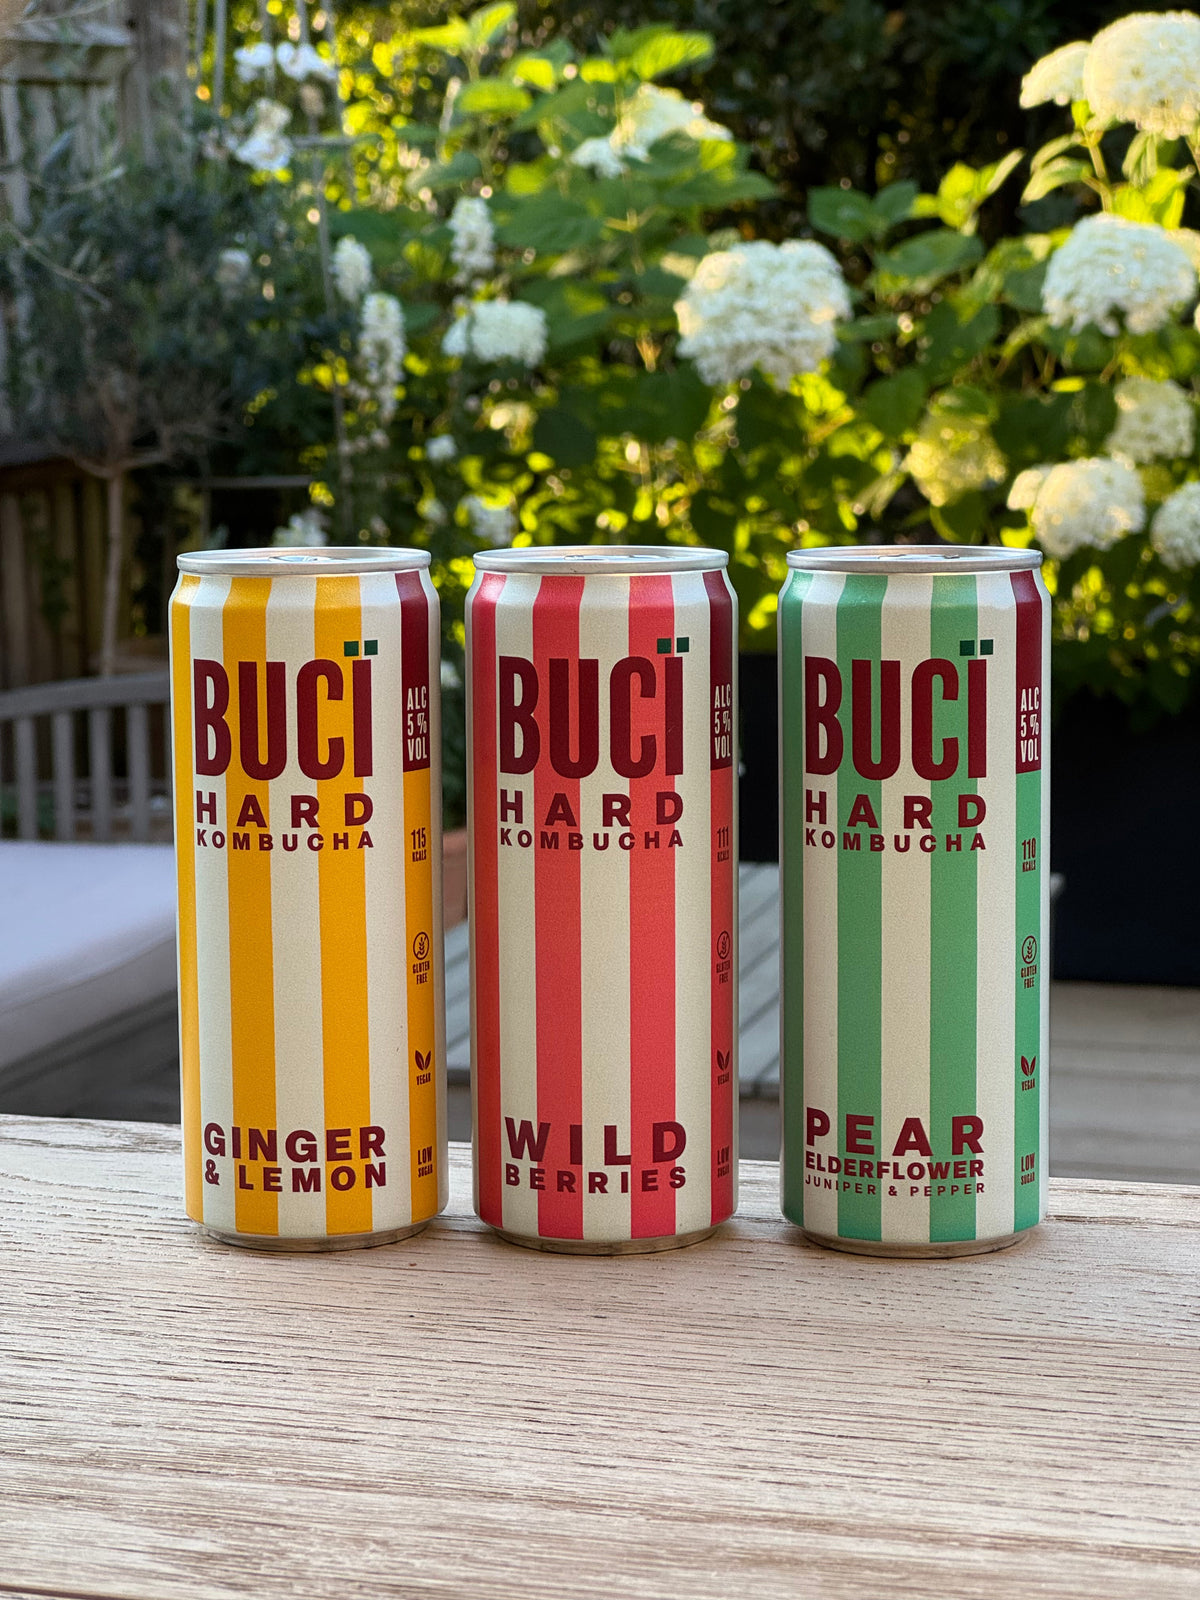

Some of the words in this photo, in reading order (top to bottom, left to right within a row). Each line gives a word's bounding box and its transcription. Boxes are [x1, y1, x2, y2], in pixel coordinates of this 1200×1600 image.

[407, 686, 427, 710] ALC
[714, 684, 731, 709] ALC
[1021, 686, 1039, 711] ALC
[407, 737, 427, 761] VOL
[714, 735, 731, 759] VOL
[1021, 738, 1039, 762] VOL
[196, 790, 373, 828] HARD
[500, 789, 683, 827] HARD
[805, 789, 986, 829] HARD
[197, 829, 374, 851] KOMBUCHA
[411, 827, 426, 850] 115
[500, 828, 683, 850] KOMBUCHA
[717, 826, 729, 848] 111
[805, 828, 986, 853] KOMBUCHA
[1021, 837, 1036, 860] 110
[412, 849, 427, 862] KCALS
[413, 960, 430, 974] GLUTEN
[416, 972, 428, 985] FREE
[1021, 964, 1037, 978] GLUTEN
[1024, 977, 1035, 989] FREE
[416, 1072, 431, 1086] VEGAN
[204, 1122, 386, 1163] GINGER
[505, 1117, 687, 1166] WILD
[806, 1107, 984, 1156] PEAR
[418, 1146, 432, 1165] LOW
[717, 1146, 729, 1165] LOW
[805, 1151, 984, 1180] ELDERFLOWER
[1021, 1152, 1035, 1172] LOW
[205, 1158, 220, 1186] &
[238, 1162, 387, 1192] LEMON
[418, 1164, 433, 1178] SUGAR
[505, 1163, 686, 1194] BERRIES
[1021, 1172, 1035, 1185] SUGAR
[805, 1174, 876, 1195] JUNIPER
[888, 1185, 898, 1196] &
[910, 1182, 985, 1197] PEPPER
